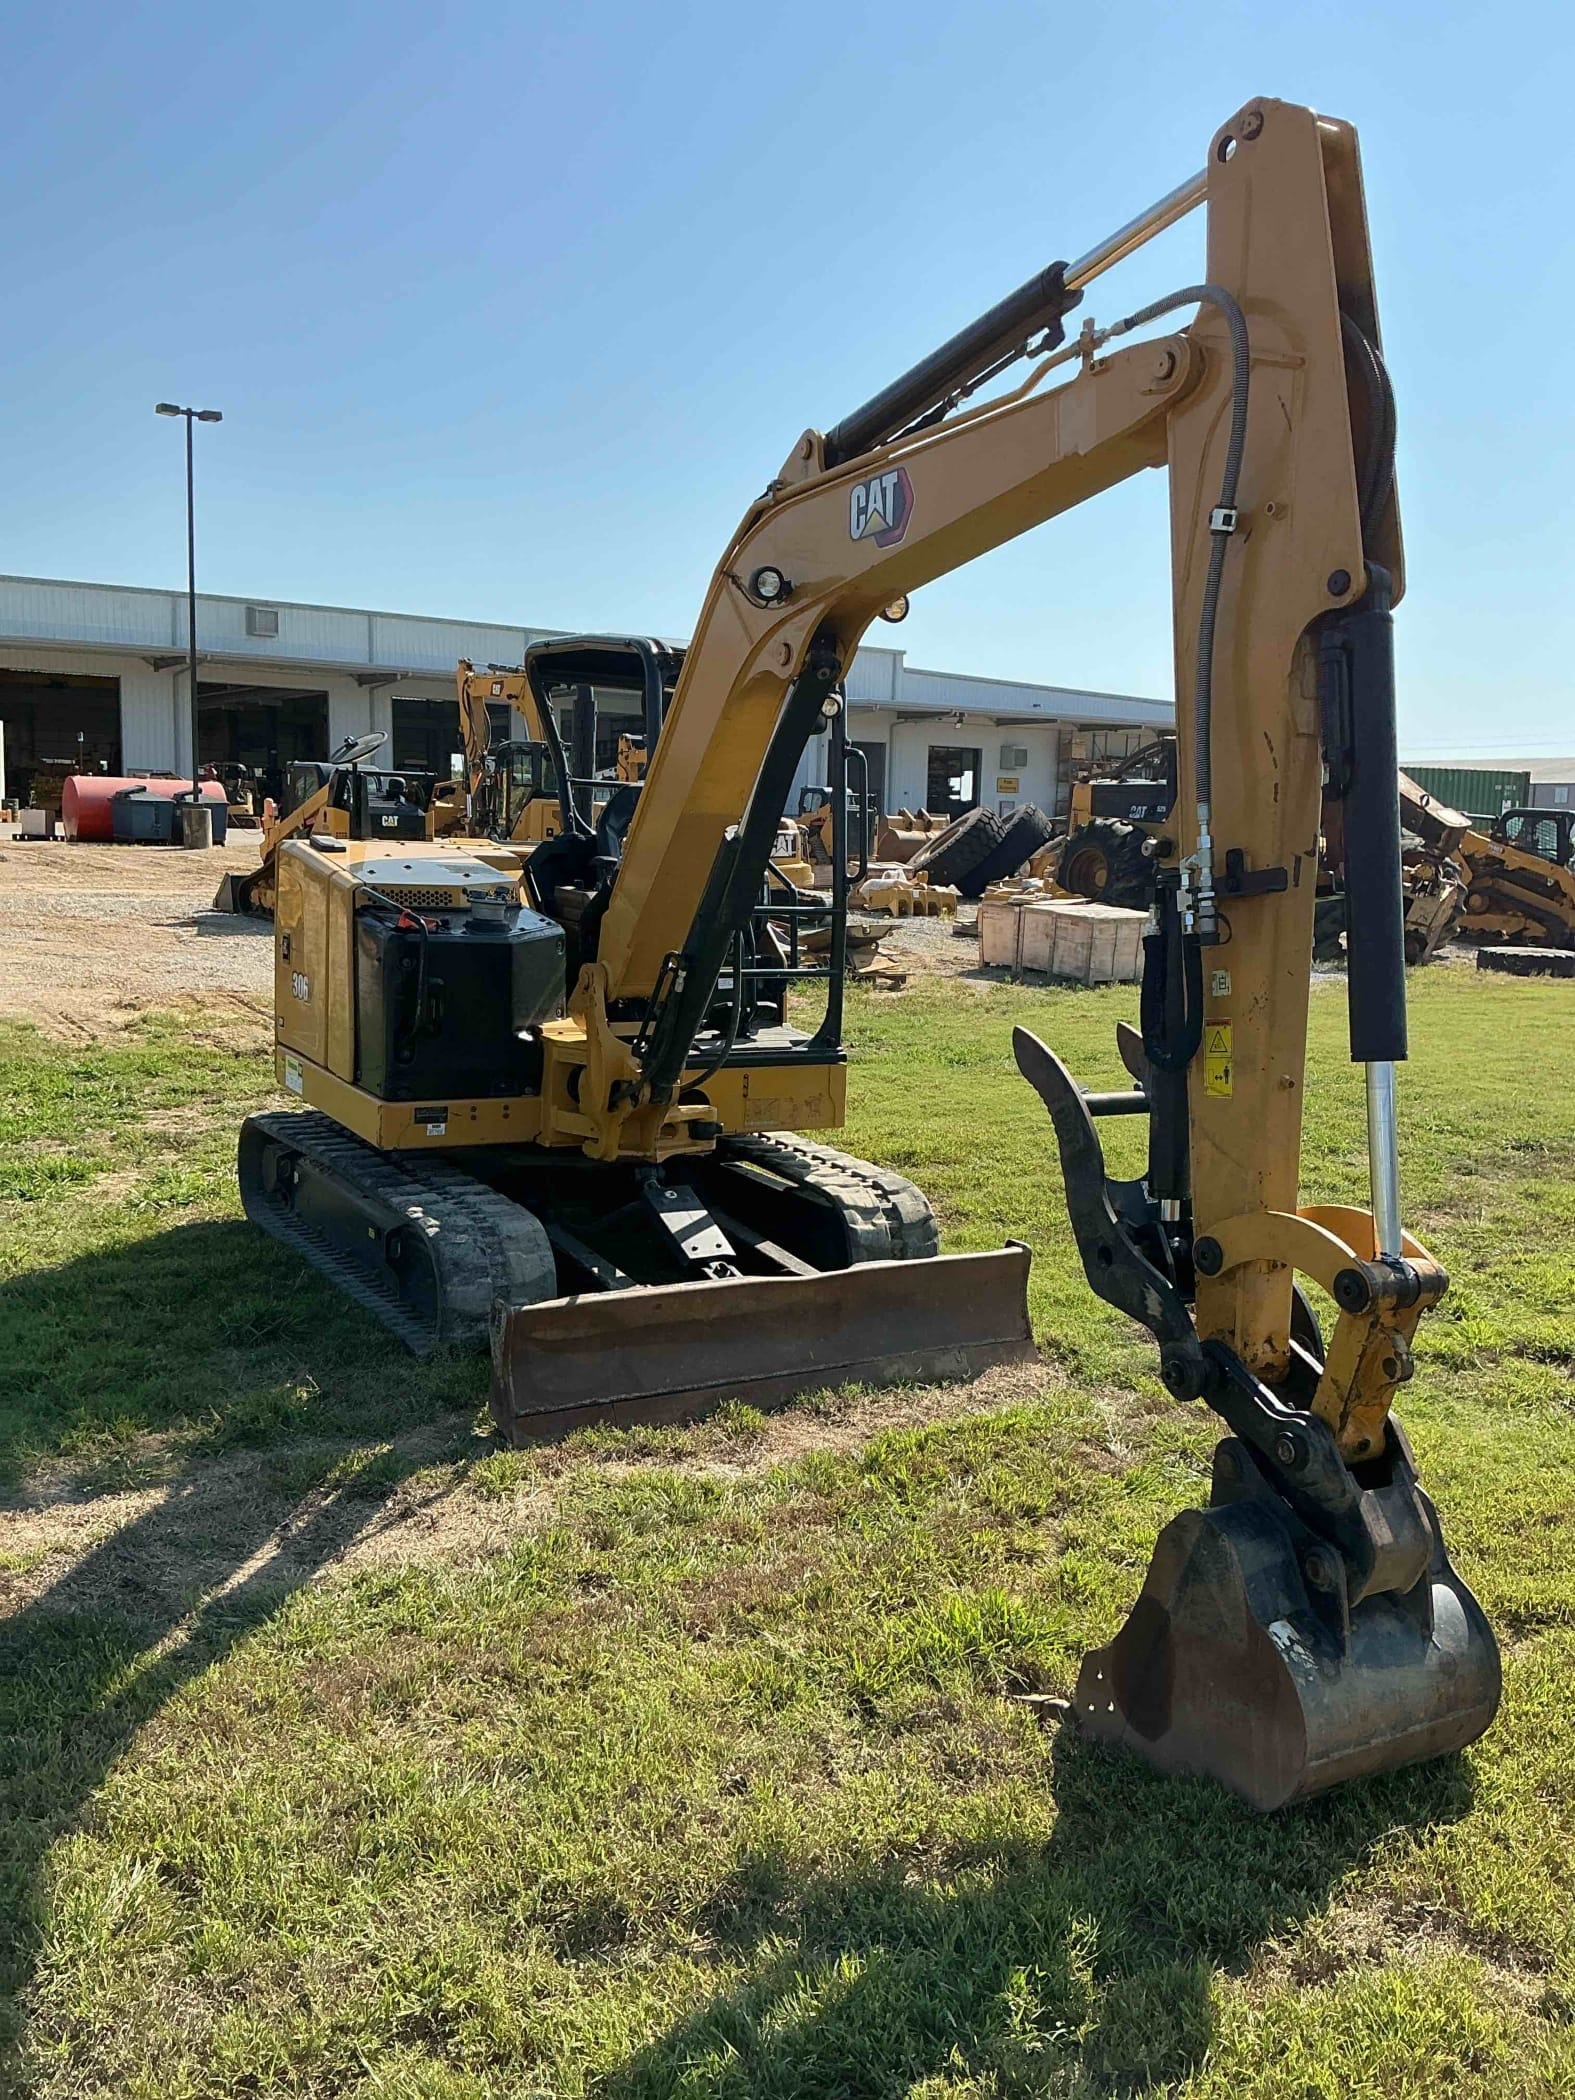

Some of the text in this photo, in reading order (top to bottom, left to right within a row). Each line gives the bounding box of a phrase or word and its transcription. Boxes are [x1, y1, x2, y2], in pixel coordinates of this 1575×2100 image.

[850, 471, 898, 540] CAT
[381, 815, 399, 827] CAT
[1129, 805, 1148, 818] CAT
[292, 971, 309, 1001] 306
